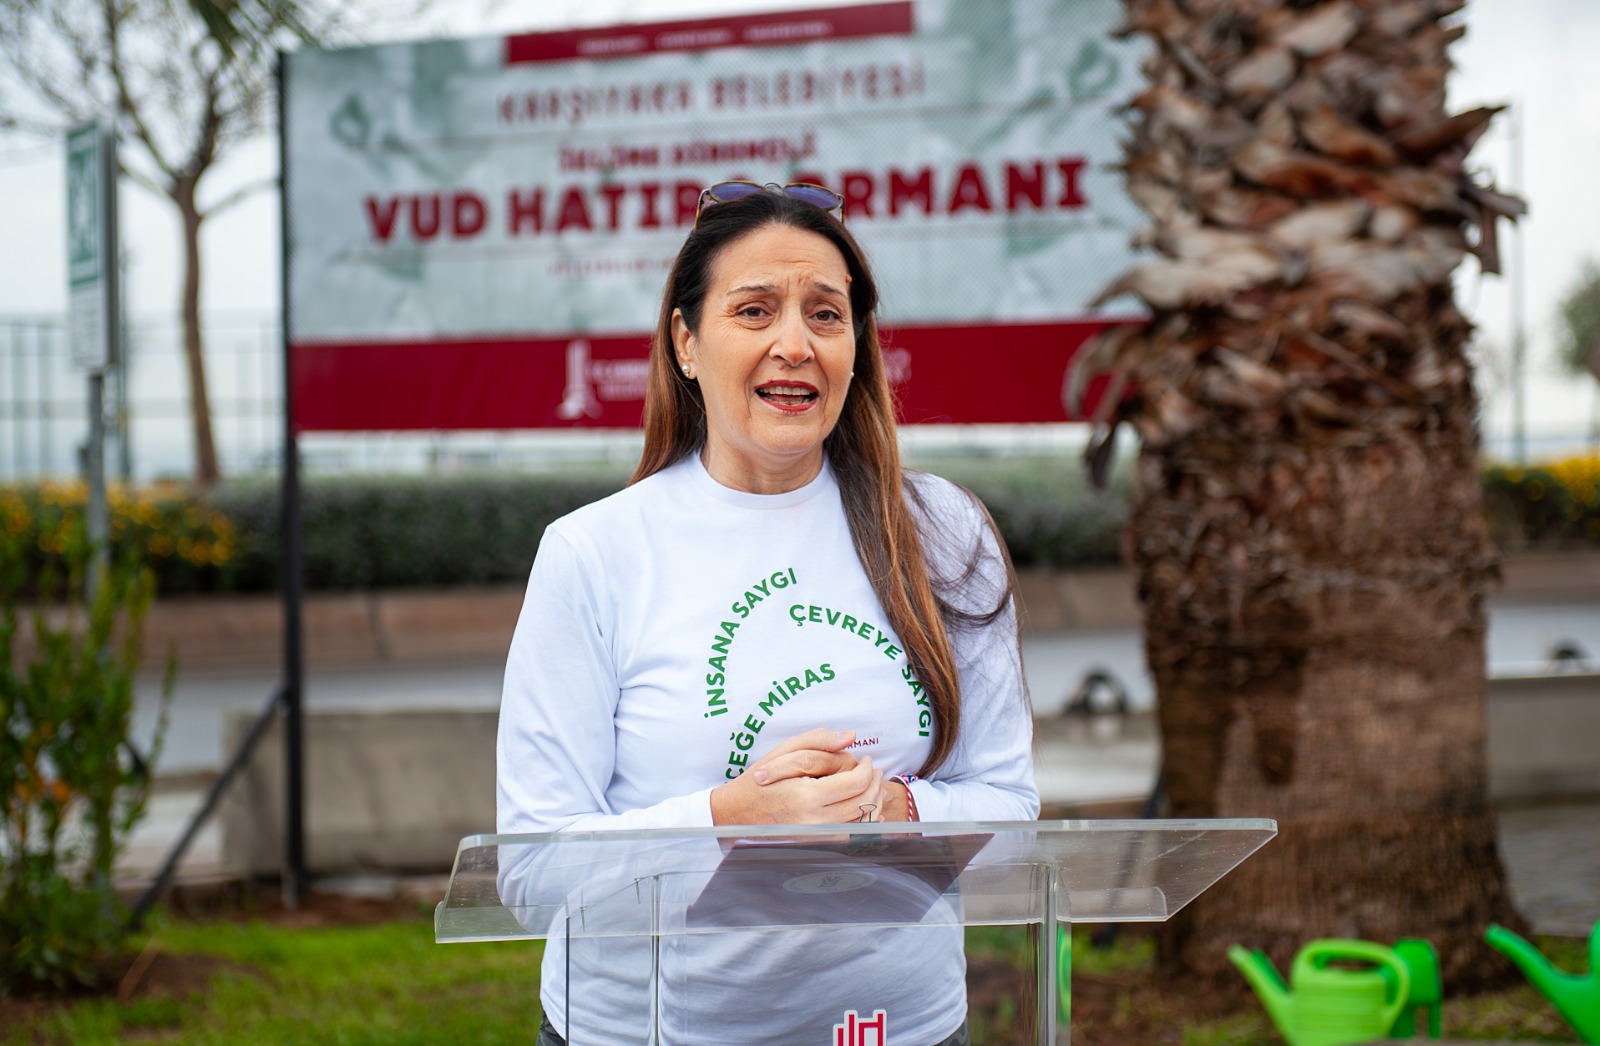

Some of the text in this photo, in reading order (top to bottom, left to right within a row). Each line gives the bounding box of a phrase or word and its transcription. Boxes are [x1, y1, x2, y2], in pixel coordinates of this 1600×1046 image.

[364, 157, 1088, 243] VUD HATIR RMANI
[703, 567, 798, 719] İNSANA SAYGI
[788, 603, 932, 738] ÇEVREYE SAYGI
[725, 663, 836, 784] CEĞE MİRAS
